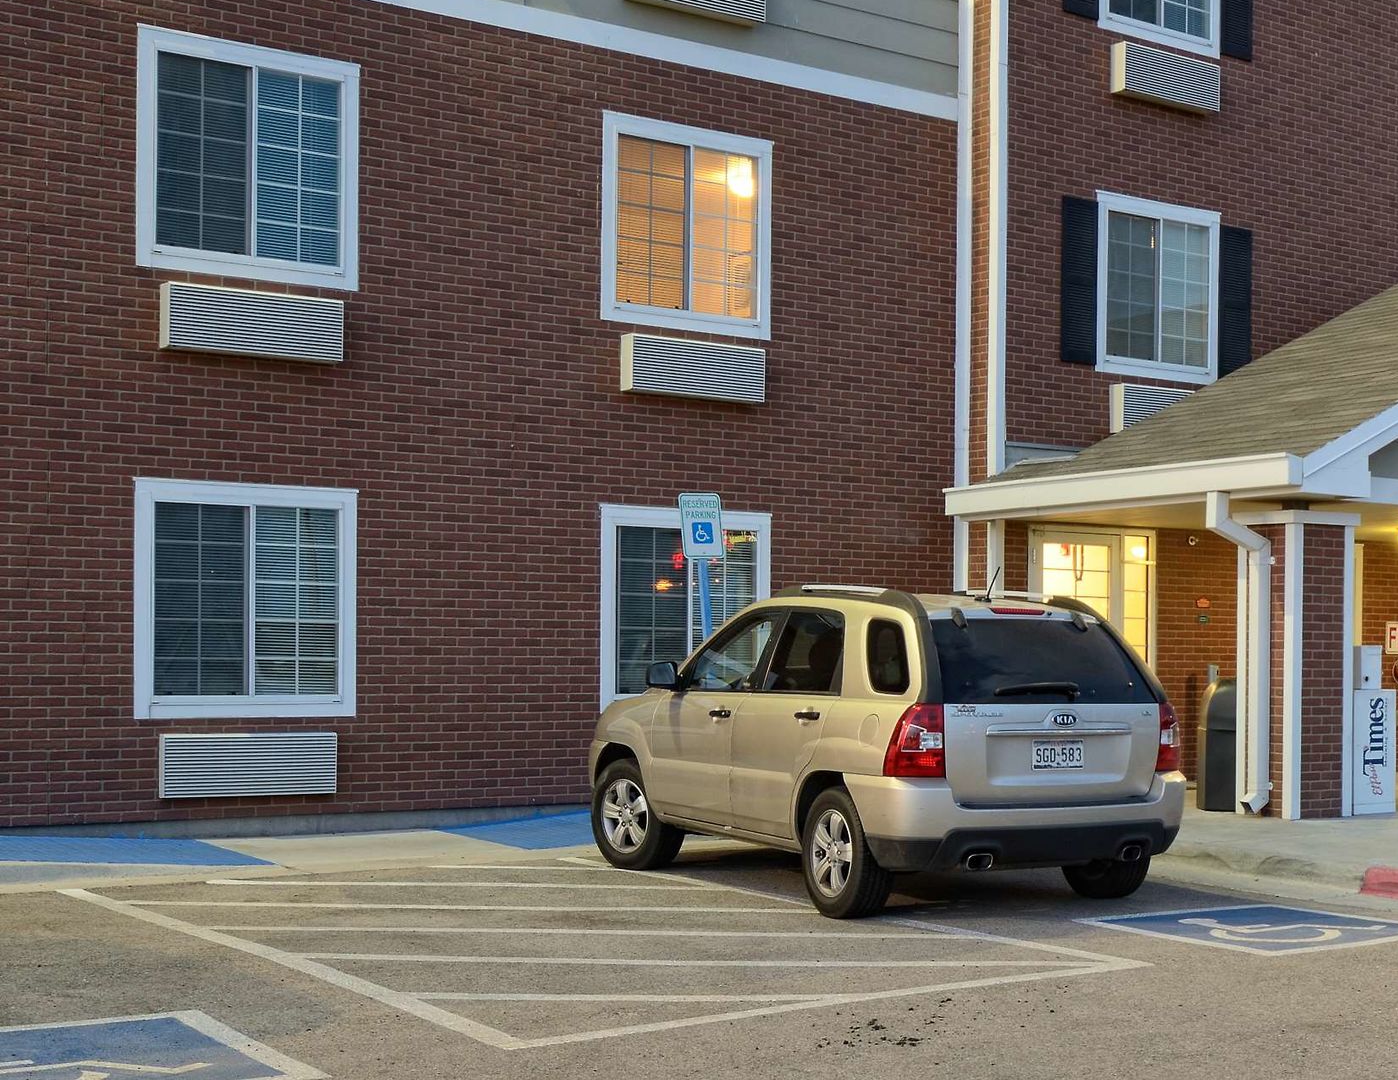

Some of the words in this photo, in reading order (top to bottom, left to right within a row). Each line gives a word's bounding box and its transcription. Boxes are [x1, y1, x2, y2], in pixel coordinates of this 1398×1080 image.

[682, 499, 718, 509] RESERVED
[685, 510, 716, 519] PARKING
[1056, 715, 1074, 724] KIA
[1362, 697, 1385, 777] Times
